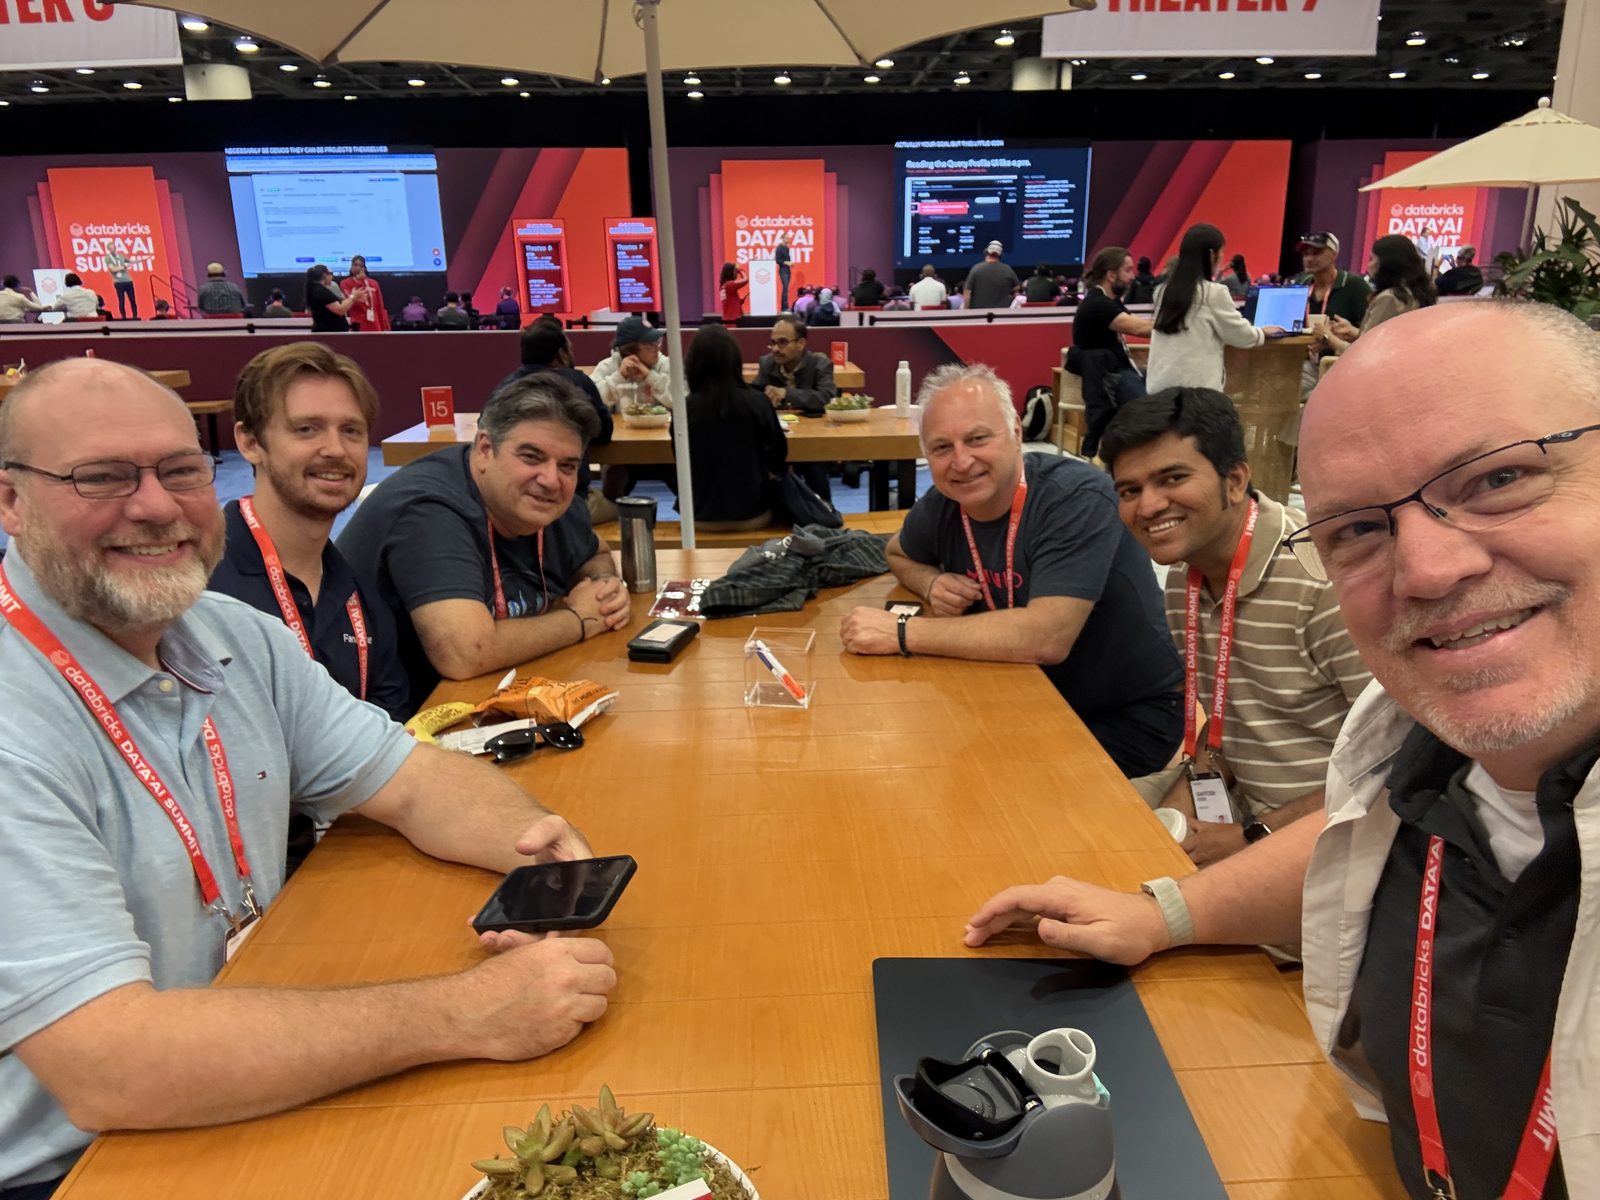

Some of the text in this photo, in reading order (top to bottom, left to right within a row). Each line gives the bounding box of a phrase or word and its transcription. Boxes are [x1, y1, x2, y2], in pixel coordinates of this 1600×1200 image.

[85, 223, 151, 235] databricks
[750, 214, 814, 228] databricks
[1404, 203, 1465, 216] databricks
[75, 255, 155, 272] SUIT
[430, 401, 448, 418] 15
[269, 565, 295, 619] databricks
[1188, 585, 1199, 627] SUMMIT
[1222, 580, 1236, 632] databricks
[1214, 677, 1225, 720] SUMMIT
[65, 667, 123, 739] databricks
[164, 798, 201, 857] SUMMIT
[210, 743, 234, 818] databricks
[1412, 939, 1431, 1067] databricks
